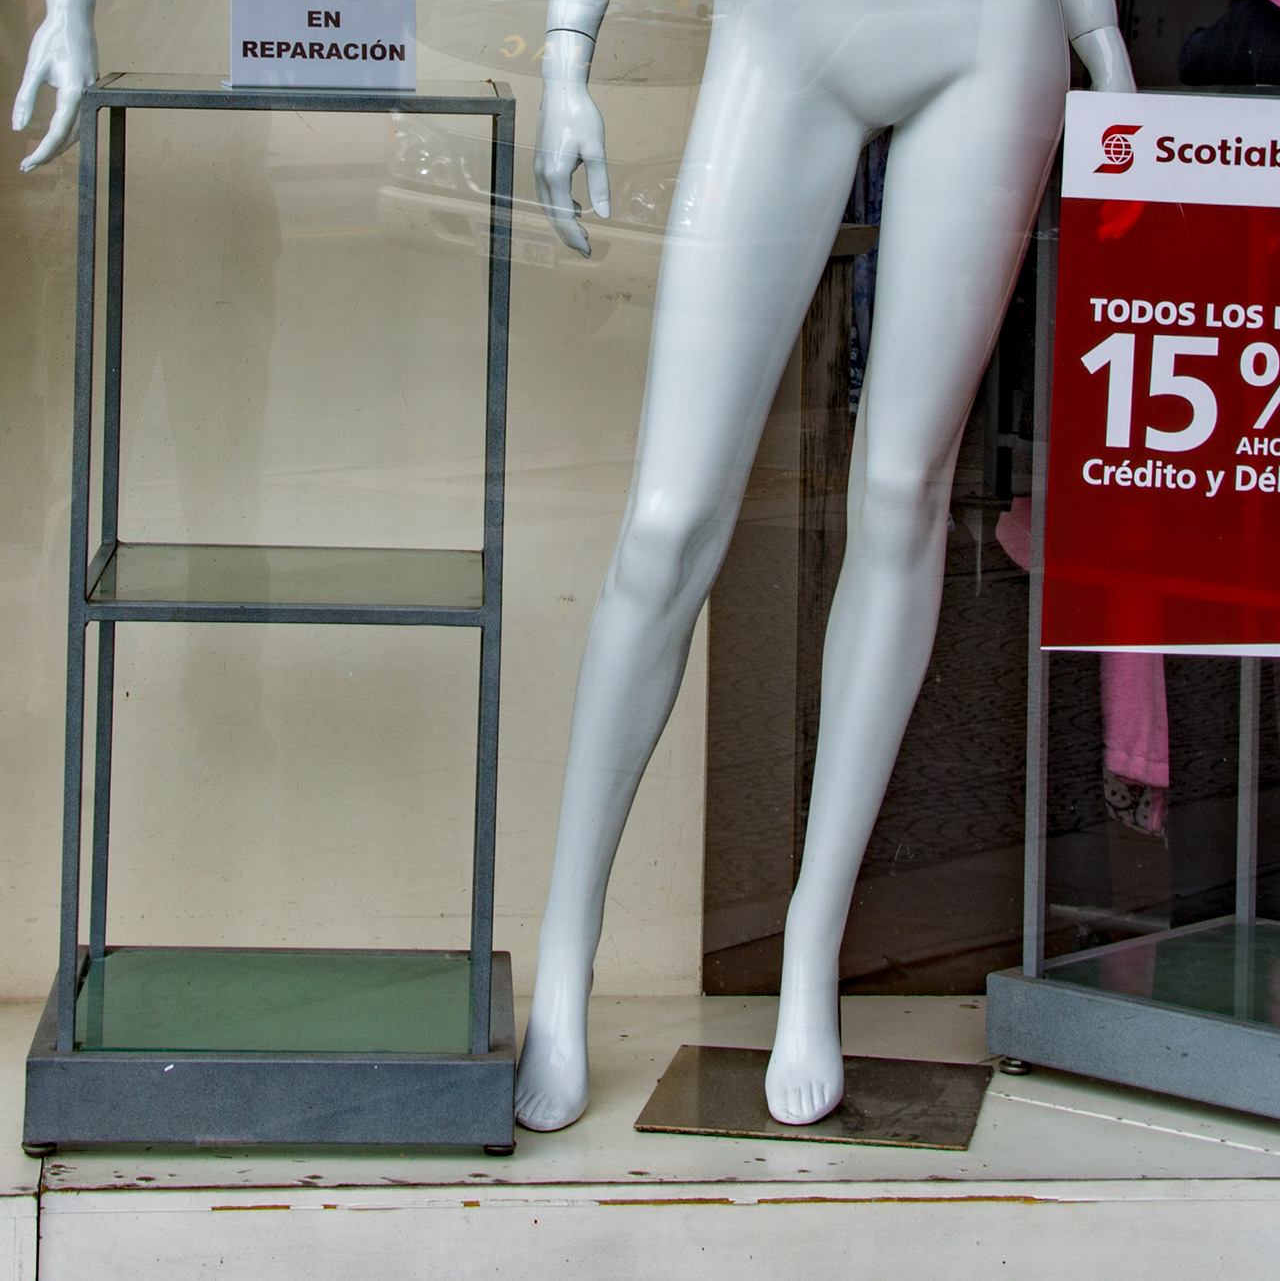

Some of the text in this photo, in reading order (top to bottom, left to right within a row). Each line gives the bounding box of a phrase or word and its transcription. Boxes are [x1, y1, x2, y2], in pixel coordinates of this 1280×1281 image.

[307, 10, 341, 28] EN
[242, 39, 406, 62] REPARACIÓN
[1090, 297, 1196, 327] TODOS
[1206, 303, 1264, 330] LOS
[1082, 458, 1197, 491] Crédito
[1205, 468, 1226, 497] y
